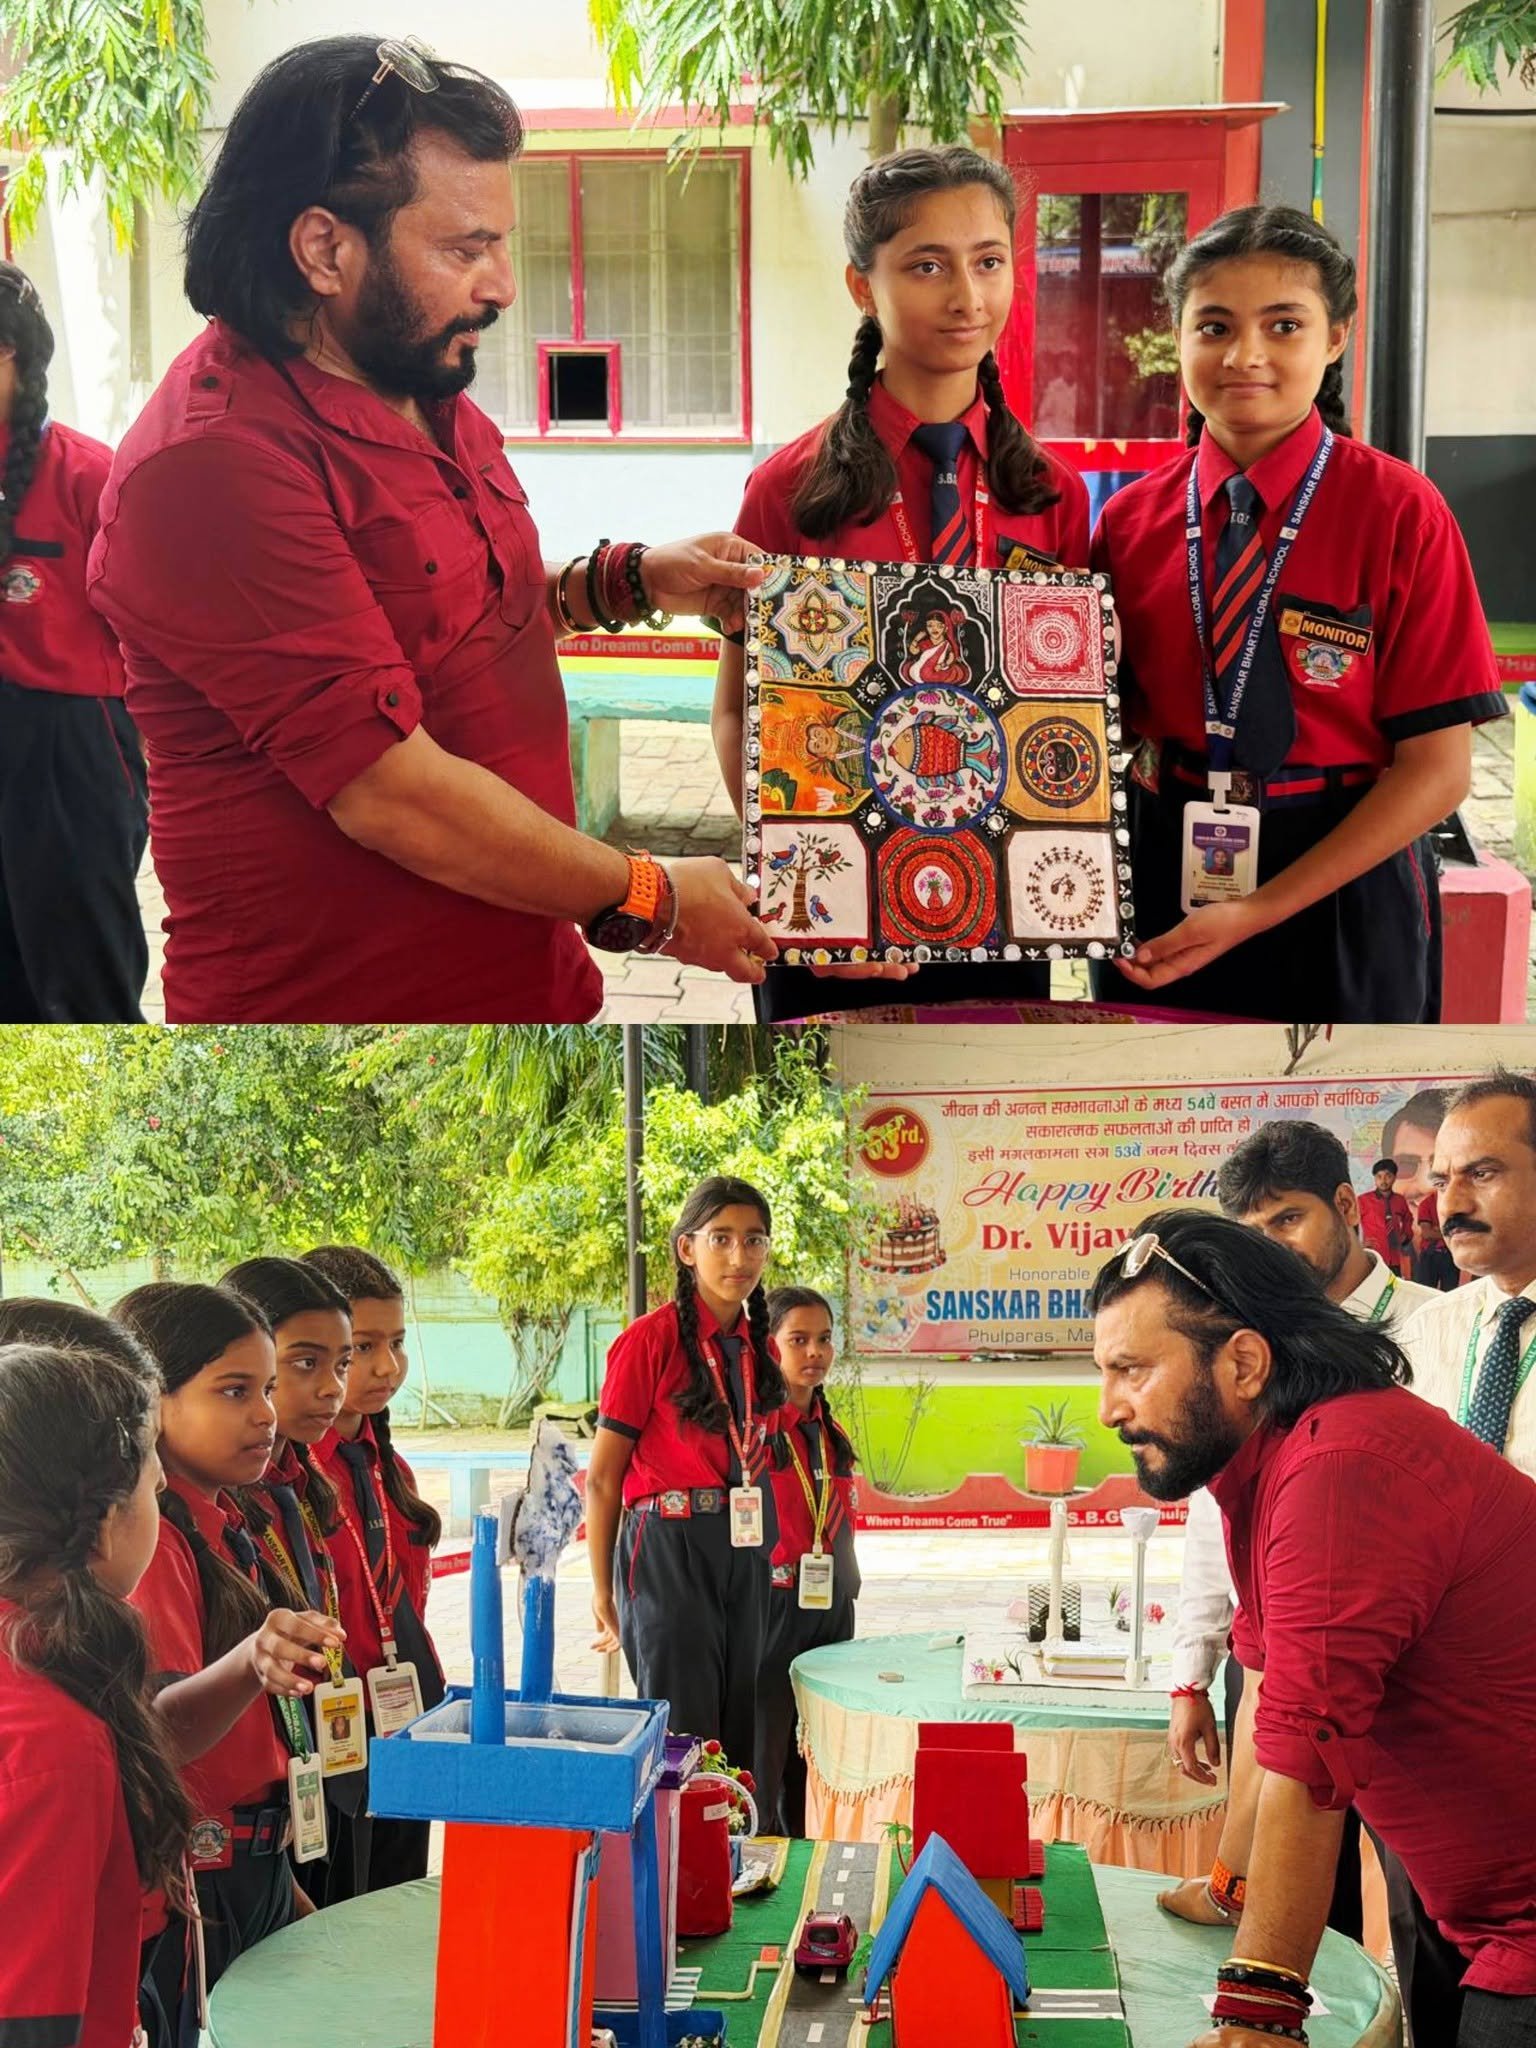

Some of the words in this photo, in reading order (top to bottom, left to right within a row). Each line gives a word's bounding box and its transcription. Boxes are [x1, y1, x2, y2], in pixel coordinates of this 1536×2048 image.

[1291, 479, 1317, 524] SANSKAR
[1311, 447, 1331, 481] BHARTI
[1023, 557, 1047, 572] MON
[1188, 542, 1198, 581] SCHOOL
[1227, 669, 1249, 720] SANSKAR
[1241, 630, 1261, 669] BHARTI
[1253, 587, 1273, 628] GLOBAL
[1266, 544, 1290, 585] SCHOOL
[1301, 620, 1367, 649] MONITOR
[592, 639, 649, 651] Dreams
[652, 640, 694, 654] Come
[941, 1099, 978, 1117] जीवन
[983, 1099, 1000, 1117] की
[1005, 1101, 1047, 1116] अनन्त
[1134, 1094, 1148, 1112] के
[1153, 1097, 1182, 1111] मध्य
[1274, 1089, 1319, 1108] आपको
[1324, 1087, 1381, 1107] सर्वाधिक
[1025, 1124, 1099, 1139] सकारात्मक
[1177, 1116, 1196, 1135] की
[1200, 1116, 1233, 1134] प्राप्ति
[1238, 1115, 1251, 1133] हो
[967, 1146, 994, 1164] इसी
[1000, 1145, 1079, 1161] मंगलकामना
[1147, 1145, 1179, 1157] जन्म
[1184, 1140, 1221, 1157] दिवस
[962, 1170, 1111, 1214] Happy
[1116, 1167, 1218, 1202] Birth
[982, 1224, 1032, 1250] Dr.
[1010, 1267, 1090, 1281] Honorable
[926, 1289, 1041, 1321] SANSKAR
[968, 1328, 1059, 1345] Phulparas,
[1067, 1328, 1094, 1342] Ma
[866, 1515, 901, 1526] Where
[902, 1514, 944, 1526] Dreams
[946, 1516, 978, 1527] Come
[981, 1514, 1013, 1526] True"
[1068, 1509, 1119, 1525] S.B.G
